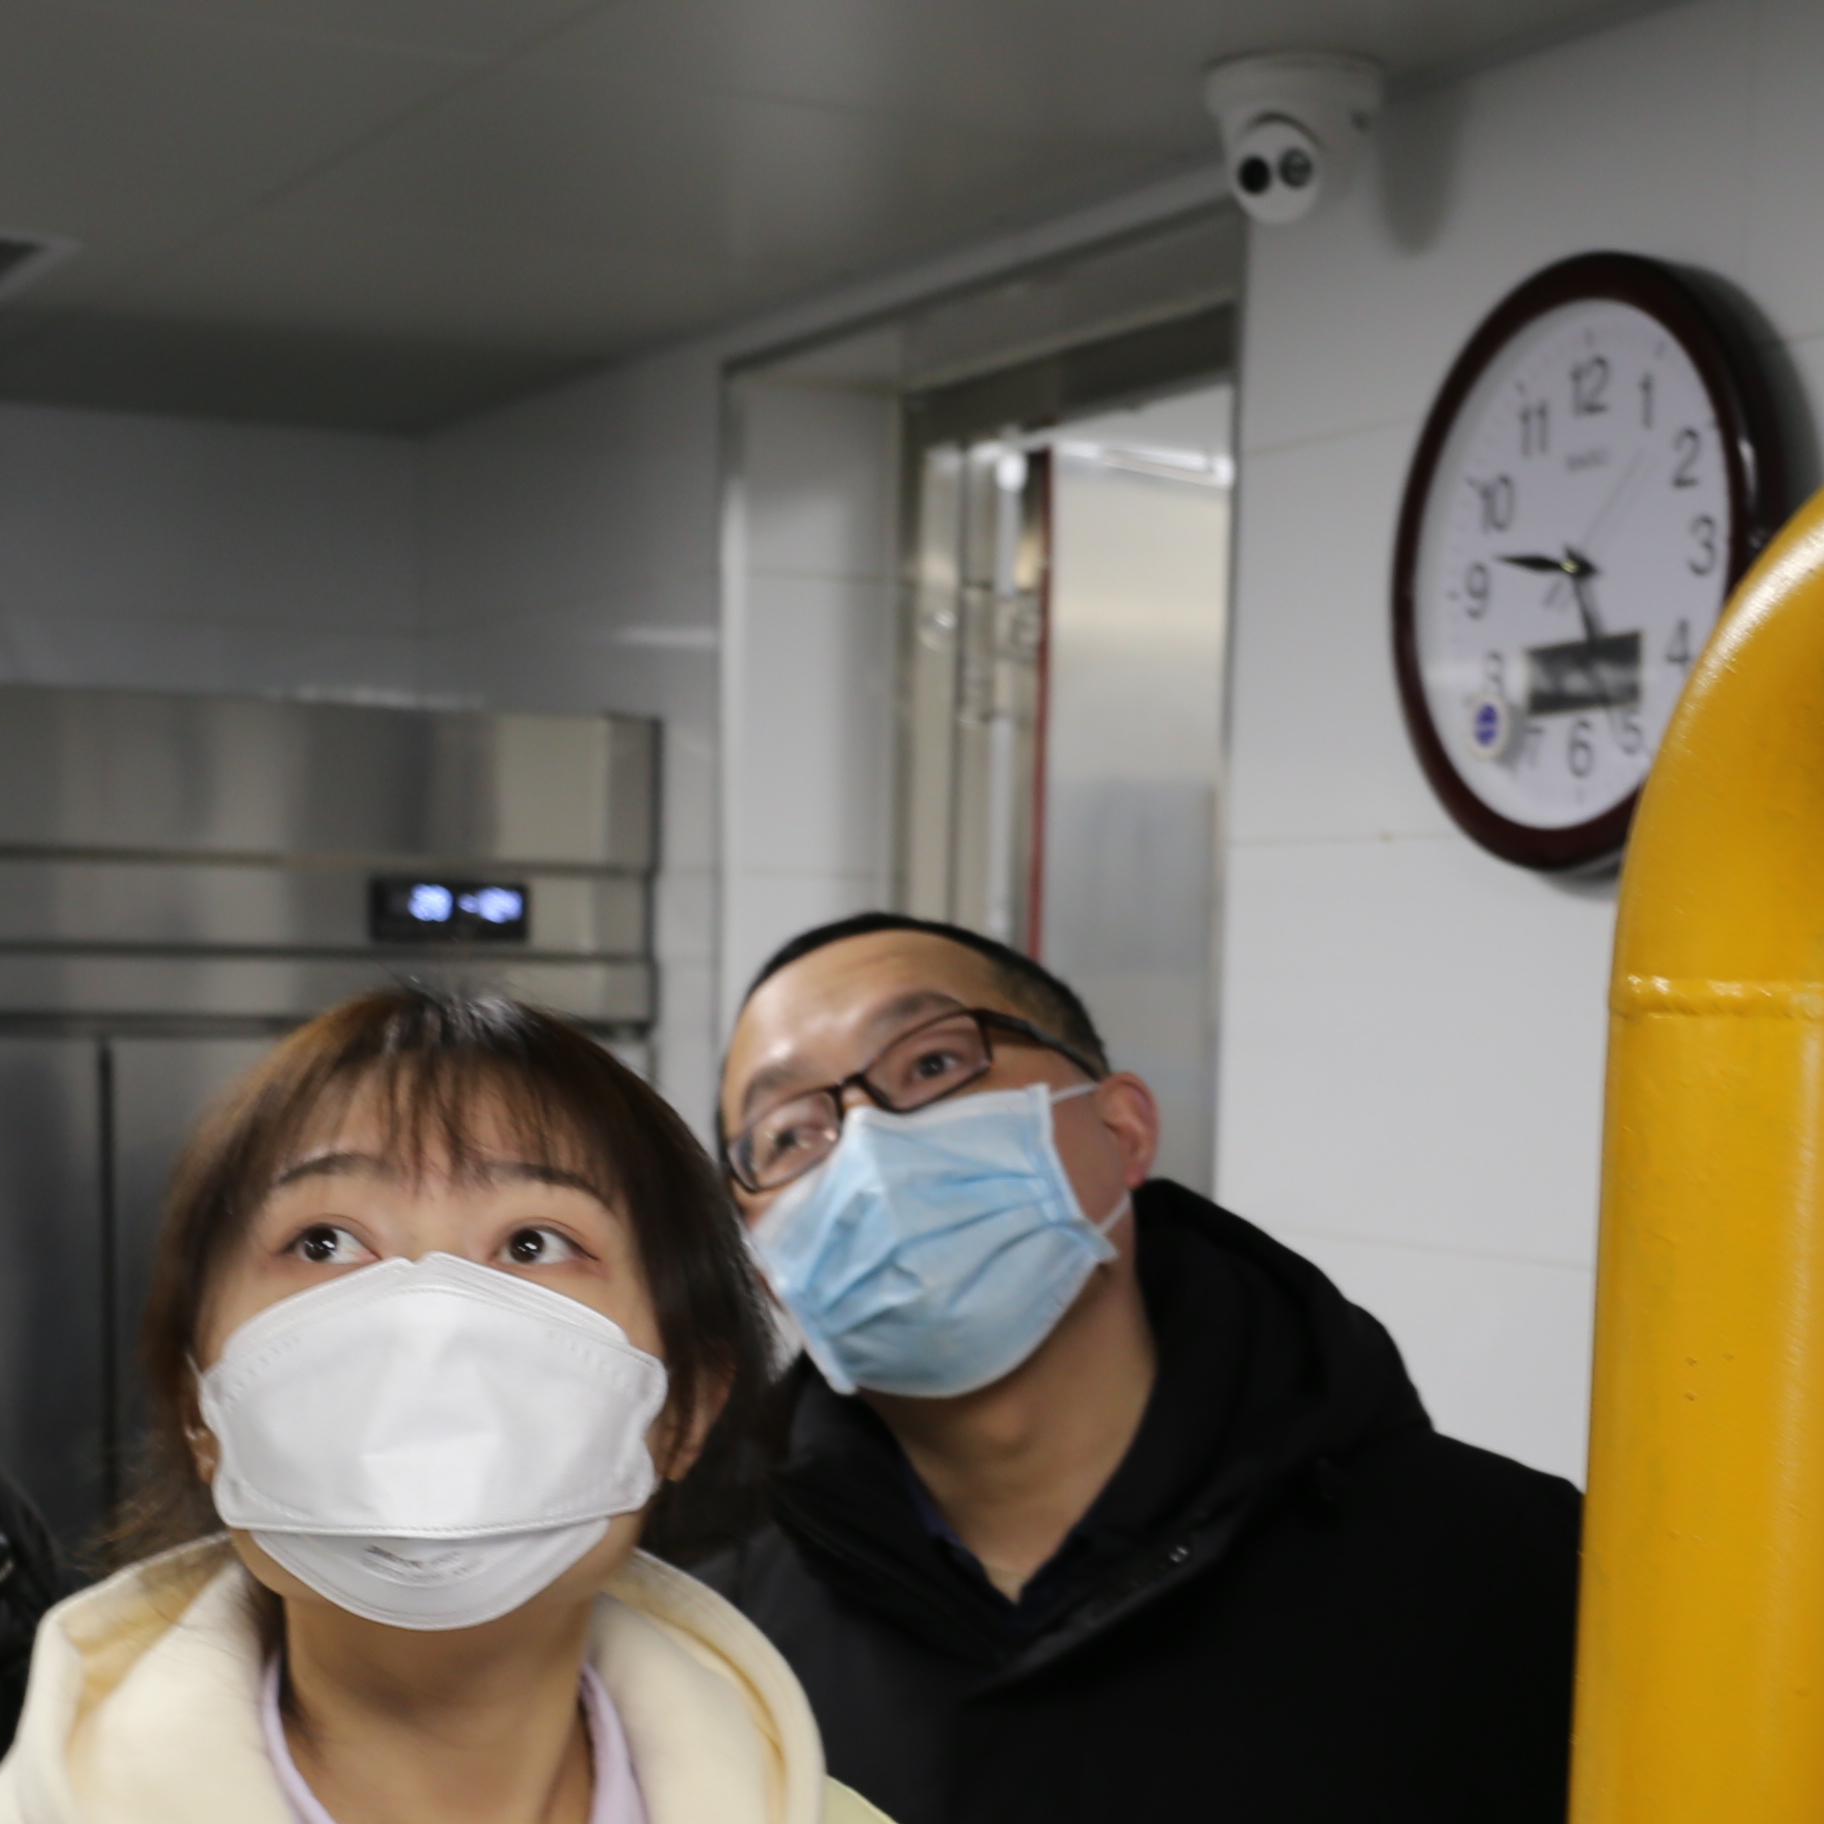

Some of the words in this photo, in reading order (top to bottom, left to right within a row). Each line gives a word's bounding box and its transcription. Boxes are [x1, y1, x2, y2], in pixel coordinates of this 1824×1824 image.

[1570, 354, 1610, 418] 12
[1639, 371, 1654, 431] 1
[1519, 398, 1549, 458] 11
[1671, 425, 1701, 488] 2
[1477, 473, 1515, 535] 10
[1690, 513, 1717, 576] 3
[1465, 562, 1490, 621] 9
[1665, 617, 1691, 673] 4
[1567, 718, 1595, 779] 6
